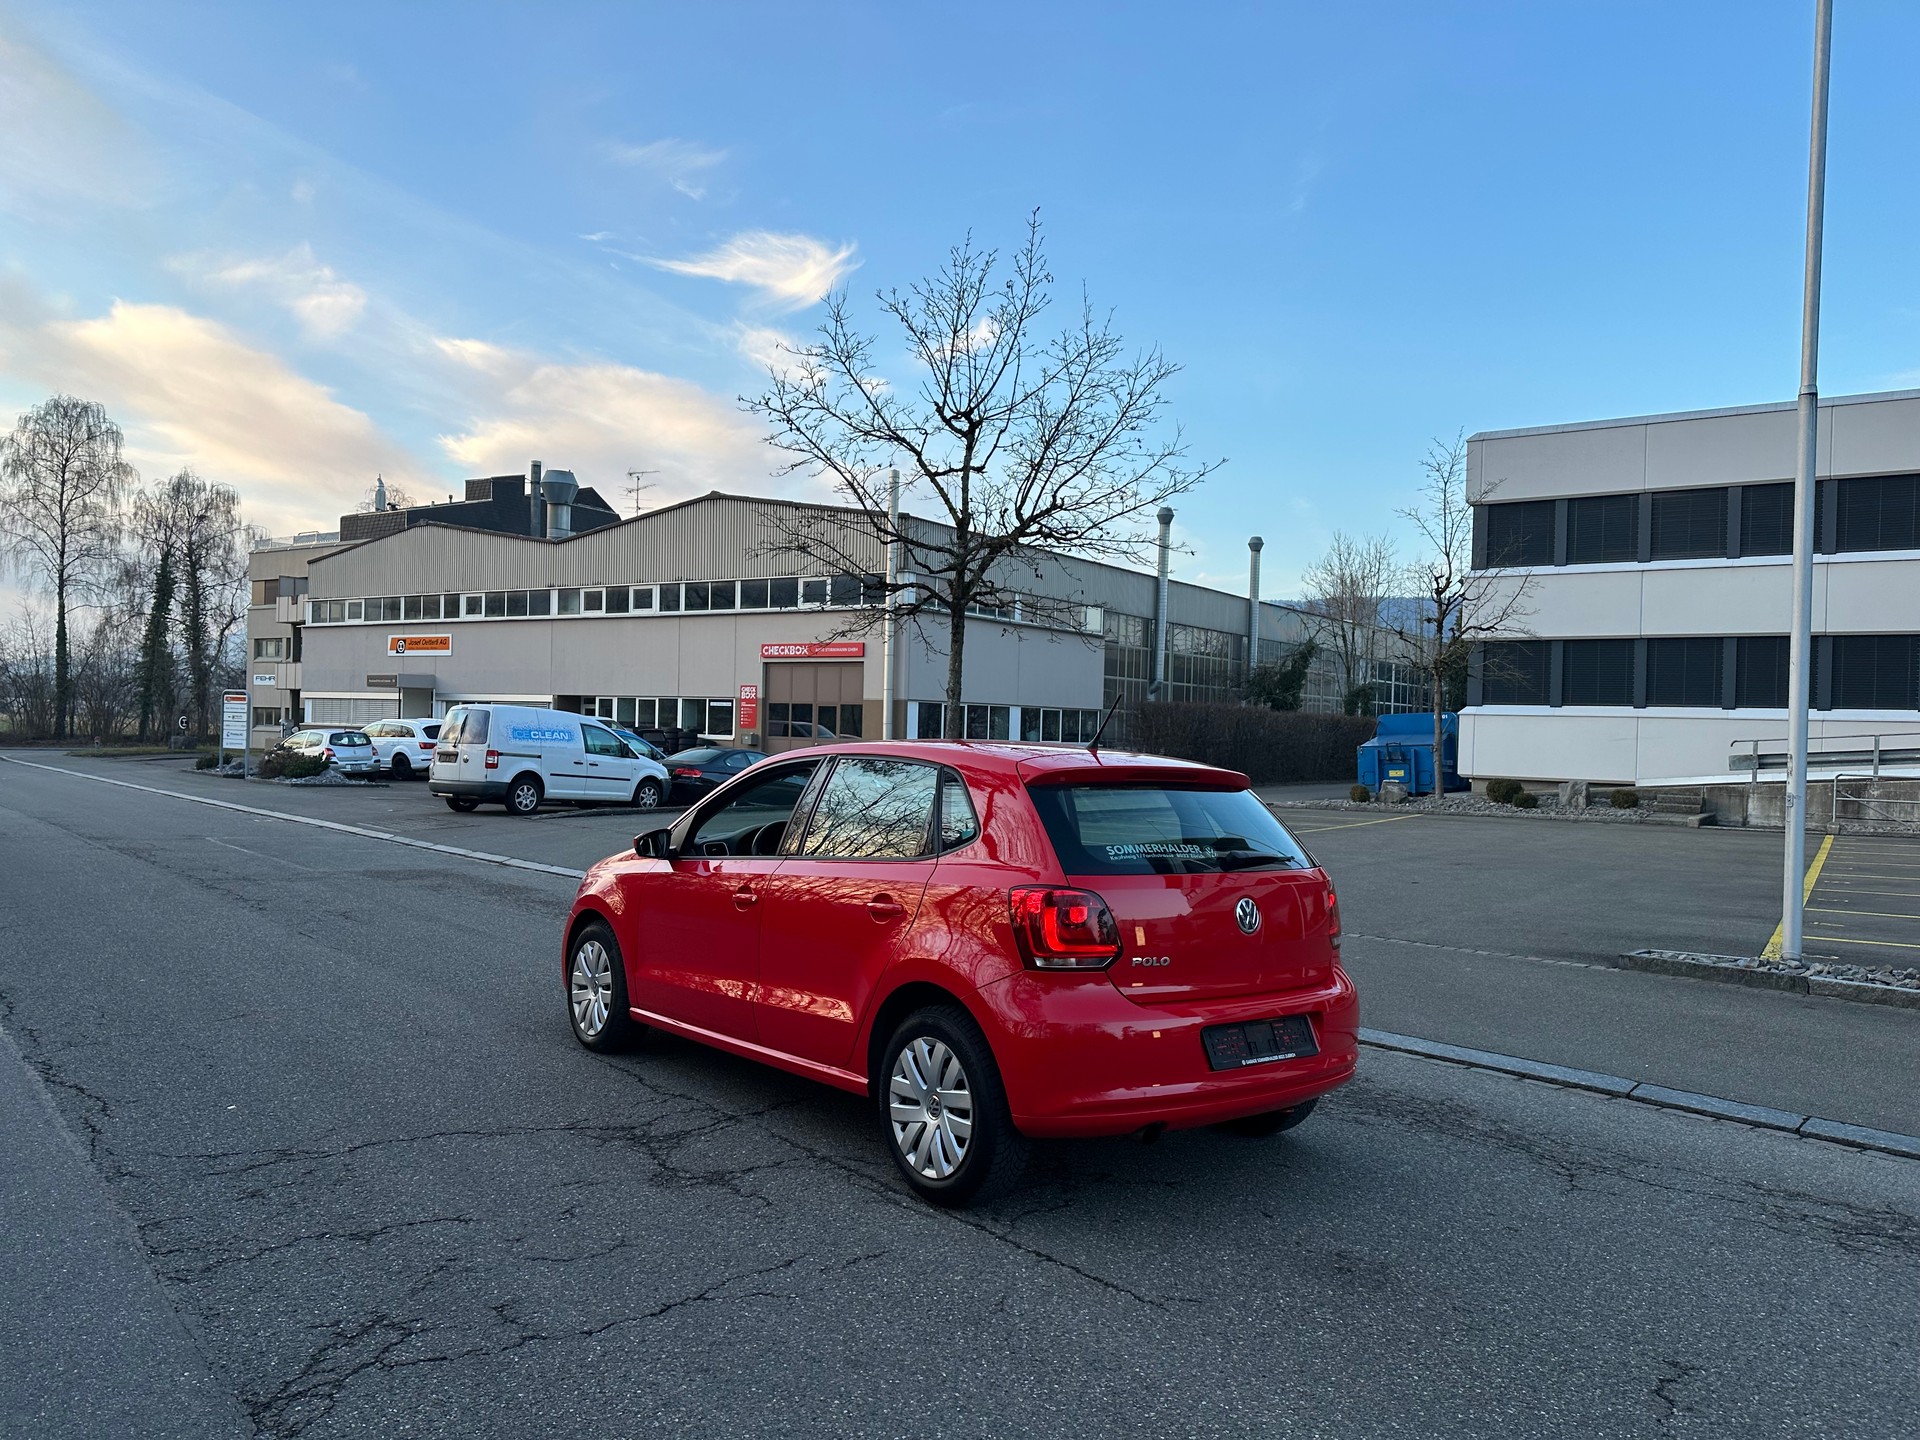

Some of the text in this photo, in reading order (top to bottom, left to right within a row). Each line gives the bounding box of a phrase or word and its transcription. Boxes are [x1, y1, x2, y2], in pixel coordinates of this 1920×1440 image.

[762, 645, 809, 655] CHECKBOX
[741, 691, 756, 699] BOX
[1106, 843, 1202, 855] SOMMERHALDER
[1132, 956, 1170, 967] POLO
